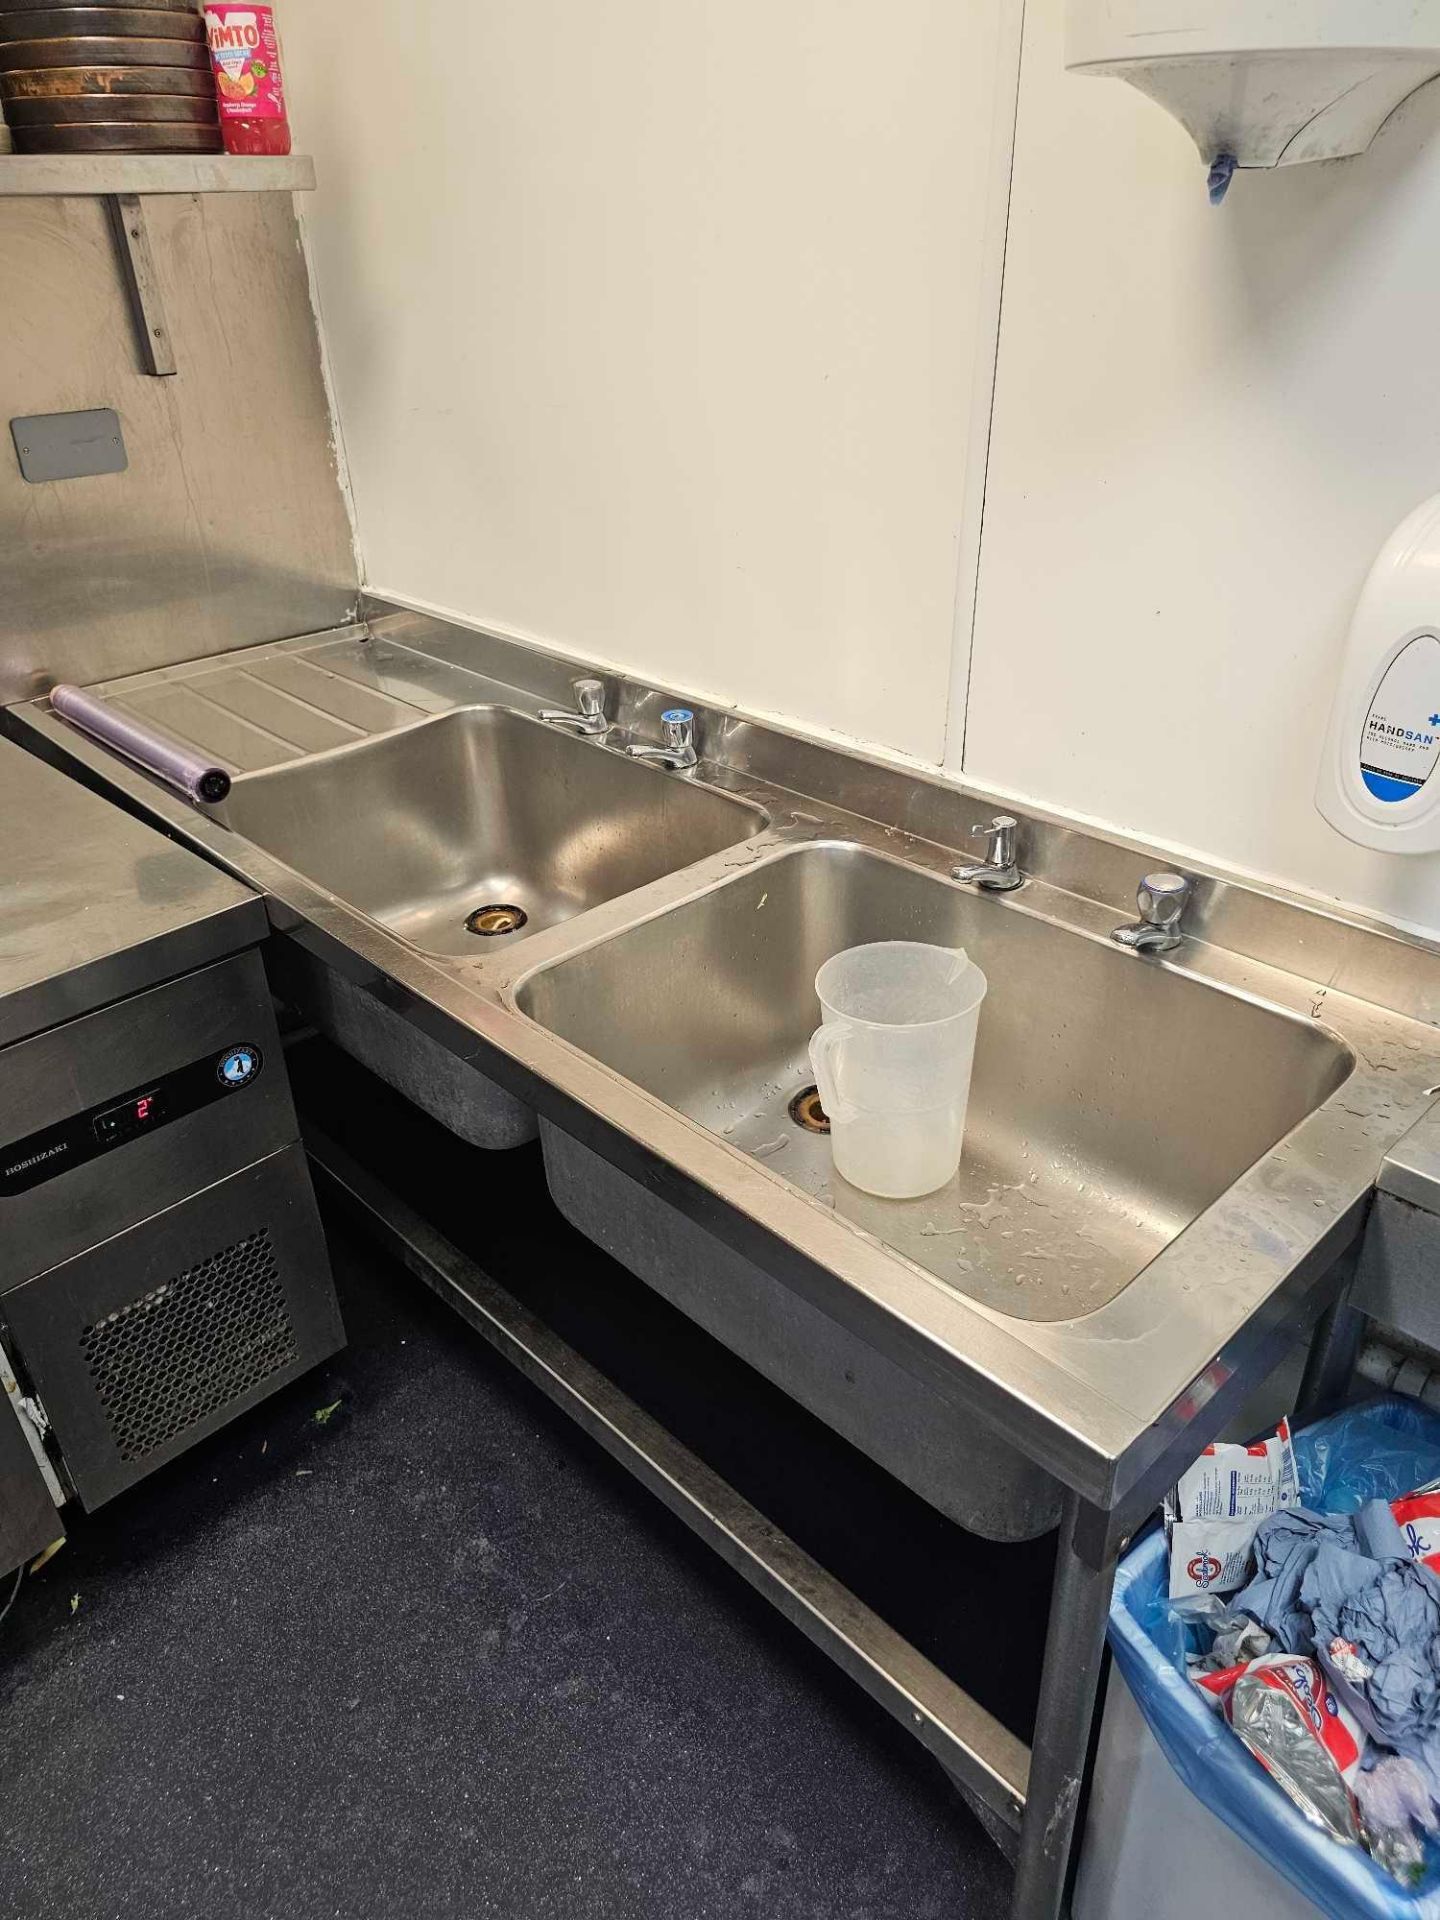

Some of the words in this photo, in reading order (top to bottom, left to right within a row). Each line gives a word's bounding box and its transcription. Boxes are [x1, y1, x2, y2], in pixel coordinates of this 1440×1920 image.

[1369, 720, 1434, 745] HANDSAN
[5, 1142, 68, 1176] HOSHIZAKI
[1196, 1550, 1210, 1589] Seabrook
